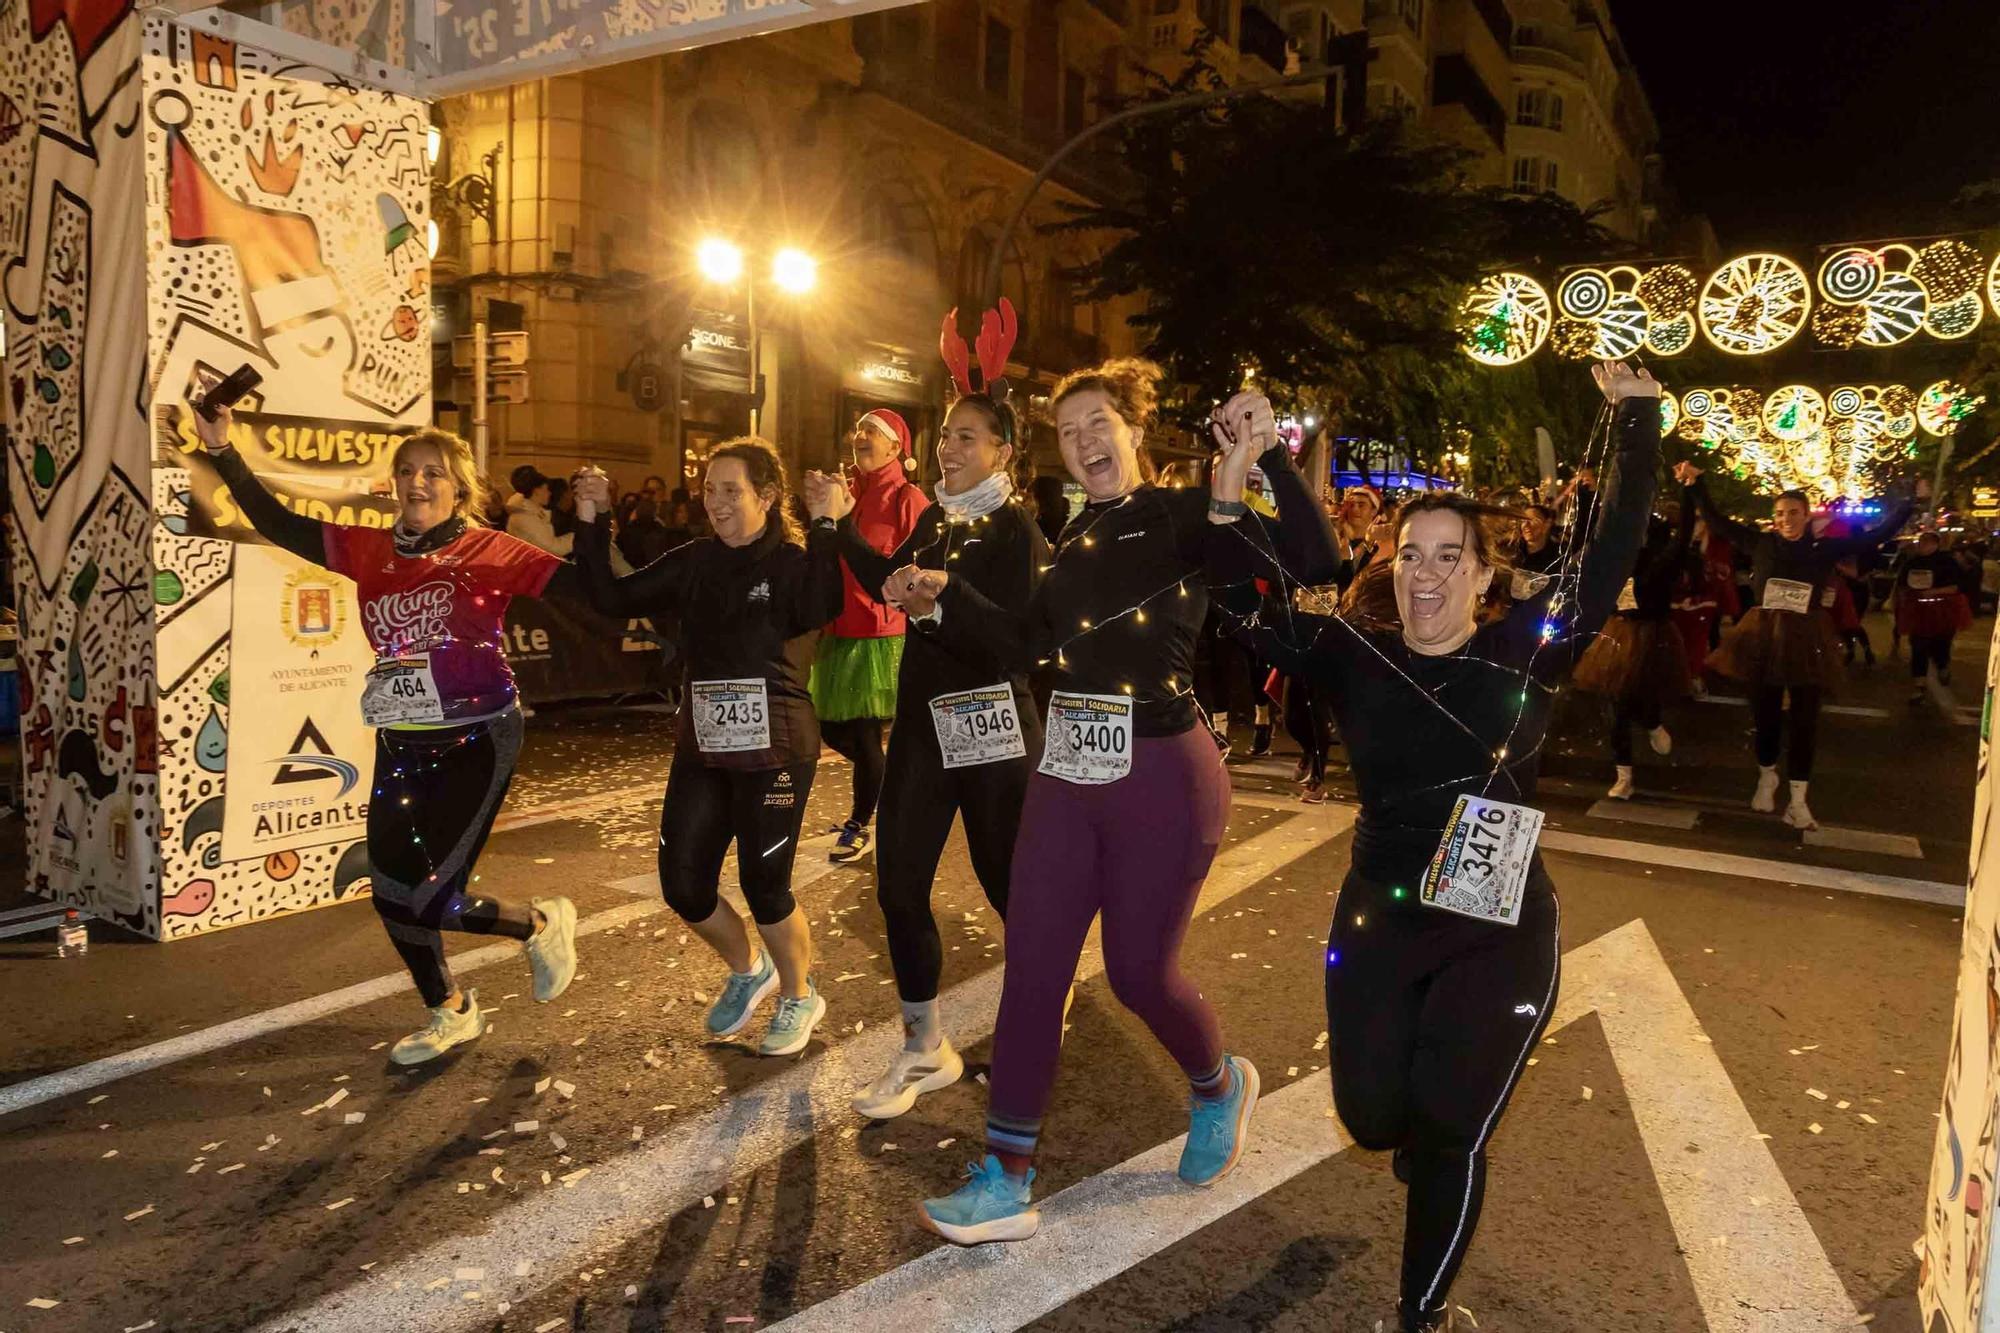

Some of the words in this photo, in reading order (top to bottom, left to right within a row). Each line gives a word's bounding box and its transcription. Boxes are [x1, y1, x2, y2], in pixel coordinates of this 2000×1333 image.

[359, 353, 409, 396] RUN
[177, 410, 253, 455] SN
[280, 683, 296, 692] DE
[299, 678, 347, 691] ALICANTE
[393, 677, 426, 698] 464
[715, 702, 763, 725] 2435
[1088, 700, 1127, 713] SOLIDARIA
[965, 708, 1014, 739] 1946
[1071, 724, 1126, 754] 3400
[253, 796, 315, 812] DEPORTES
[254, 801, 369, 837] Alicante
[1445, 835, 1463, 876] ALICANTE
[1462, 807, 1505, 877] 3476
